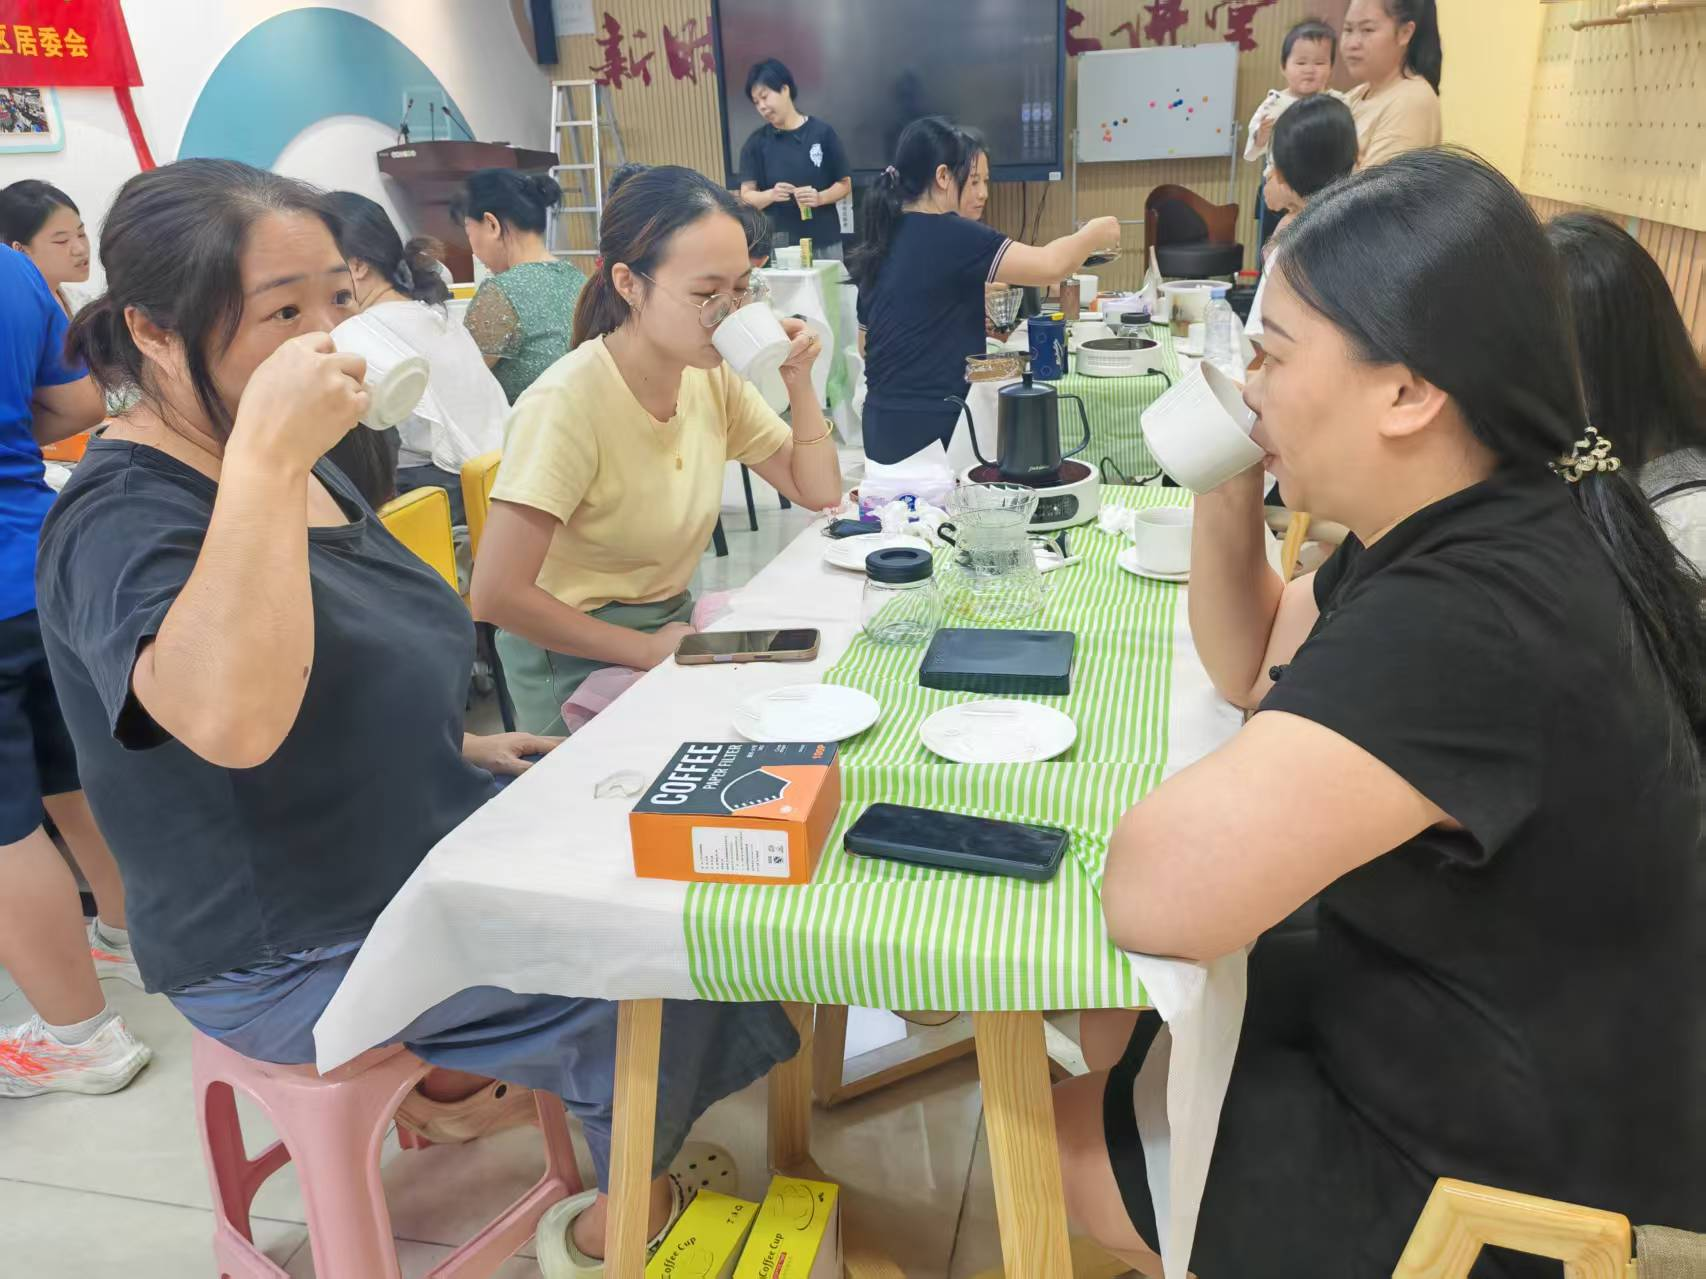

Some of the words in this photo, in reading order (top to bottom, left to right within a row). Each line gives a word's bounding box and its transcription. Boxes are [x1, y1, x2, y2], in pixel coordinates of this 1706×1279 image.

[650, 744, 723, 805] COFFEE
[702, 768, 729, 790] PAPER
[718, 744, 742, 767] FILTER
[677, 1236, 697, 1251] Cup
[759, 1250, 776, 1279] Coffee
[770, 1233, 784, 1249] Cup
